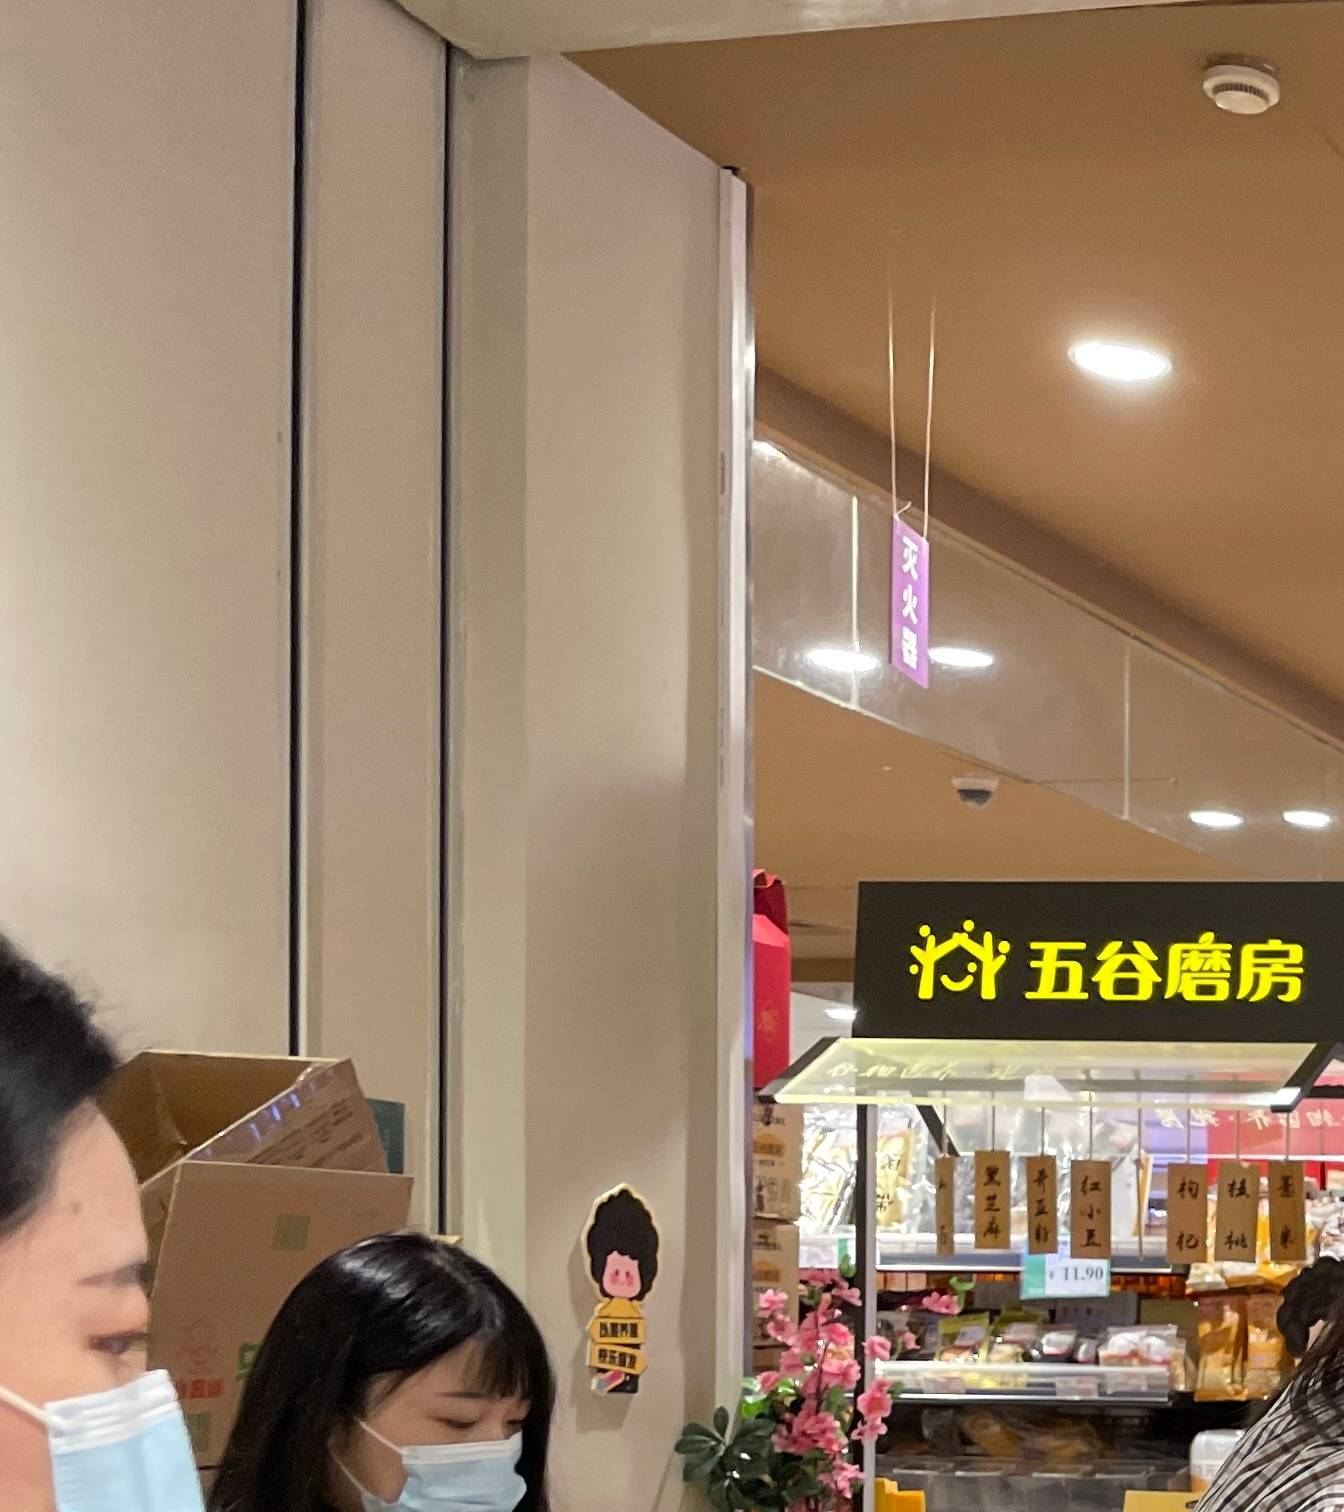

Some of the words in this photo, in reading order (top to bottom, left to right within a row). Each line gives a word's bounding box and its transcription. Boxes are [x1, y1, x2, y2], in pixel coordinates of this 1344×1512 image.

[1024, 932, 1306, 1003] 五谷磨房
[1080, 1174, 1102, 1249] 红小豆
[1062, 1266, 1105, 1282] 11.90
